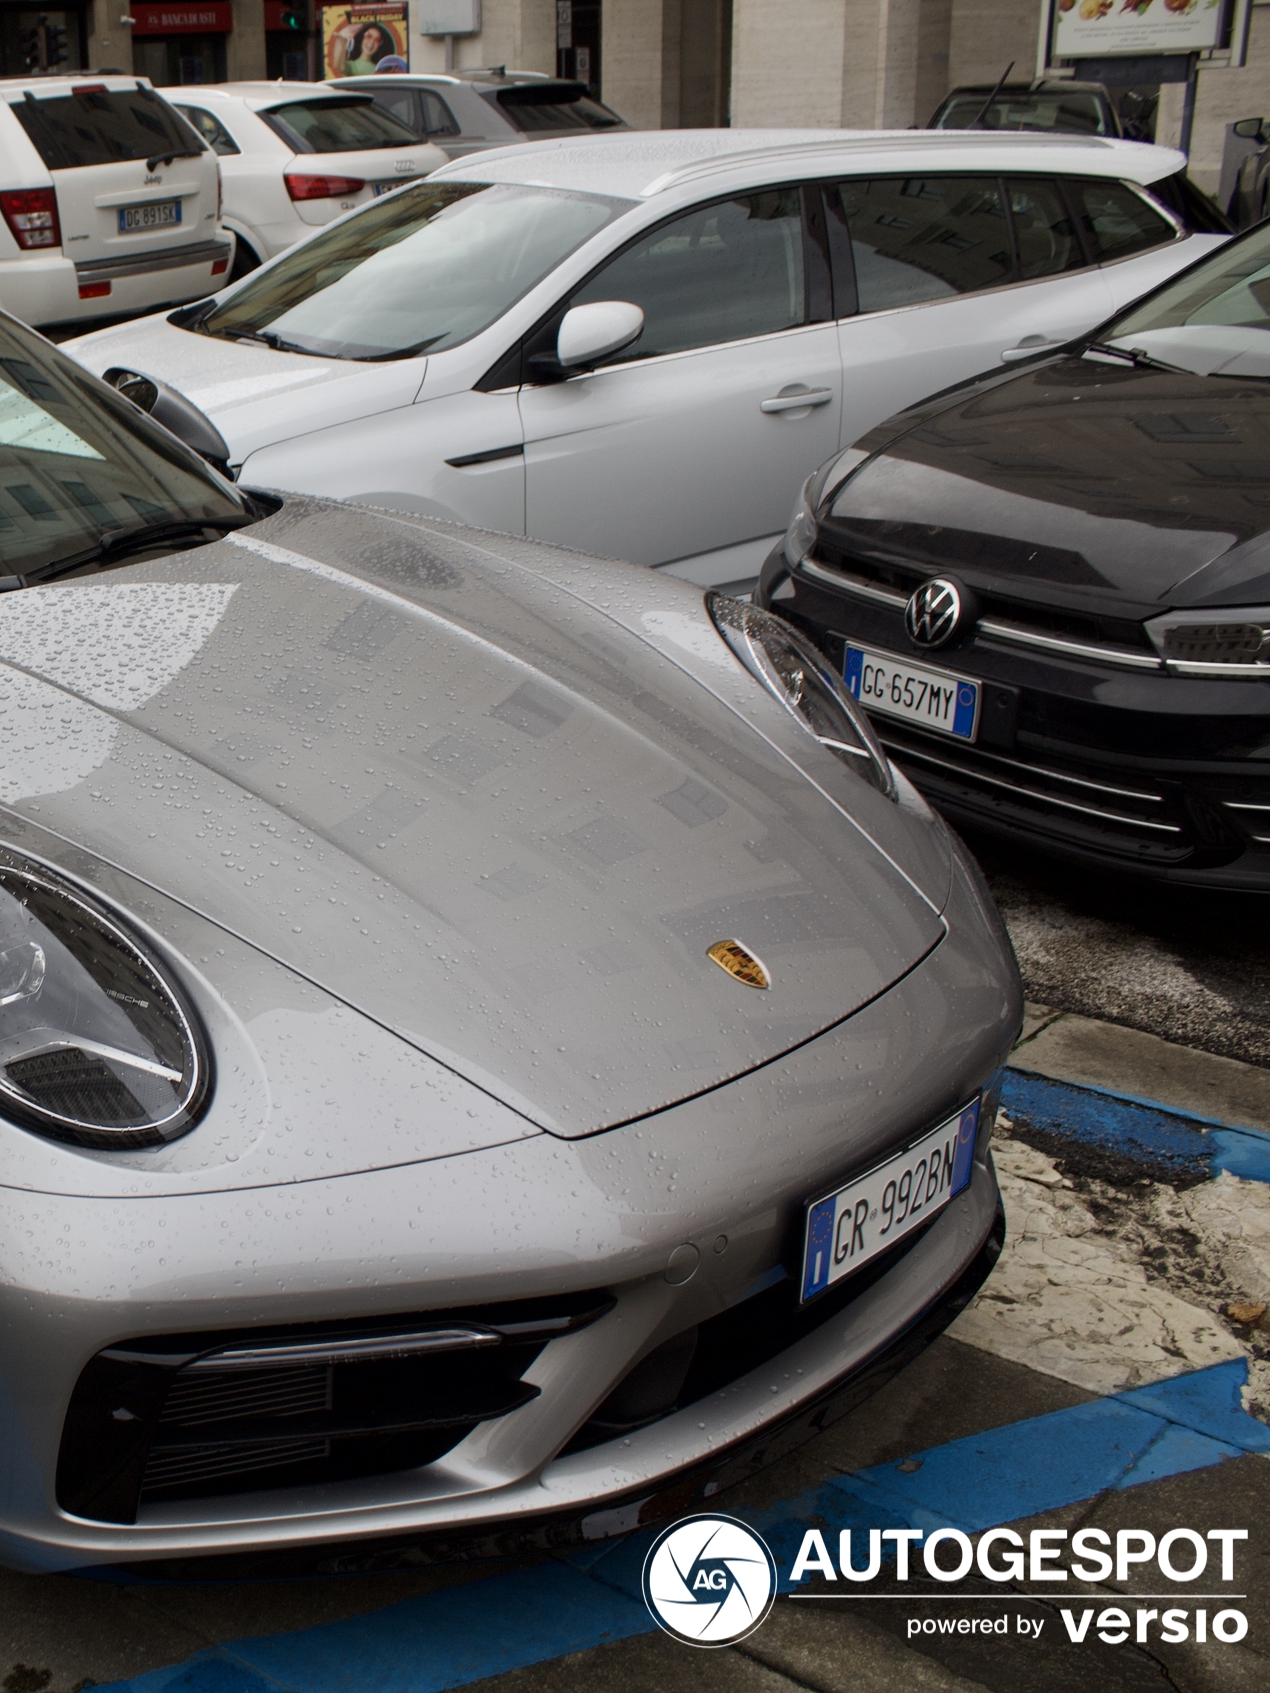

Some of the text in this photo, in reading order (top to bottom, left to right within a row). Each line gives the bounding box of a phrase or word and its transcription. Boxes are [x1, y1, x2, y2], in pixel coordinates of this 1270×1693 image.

[862, 664, 955, 720] GG 657MY
[833, 1133, 958, 1266] GR 992BN
